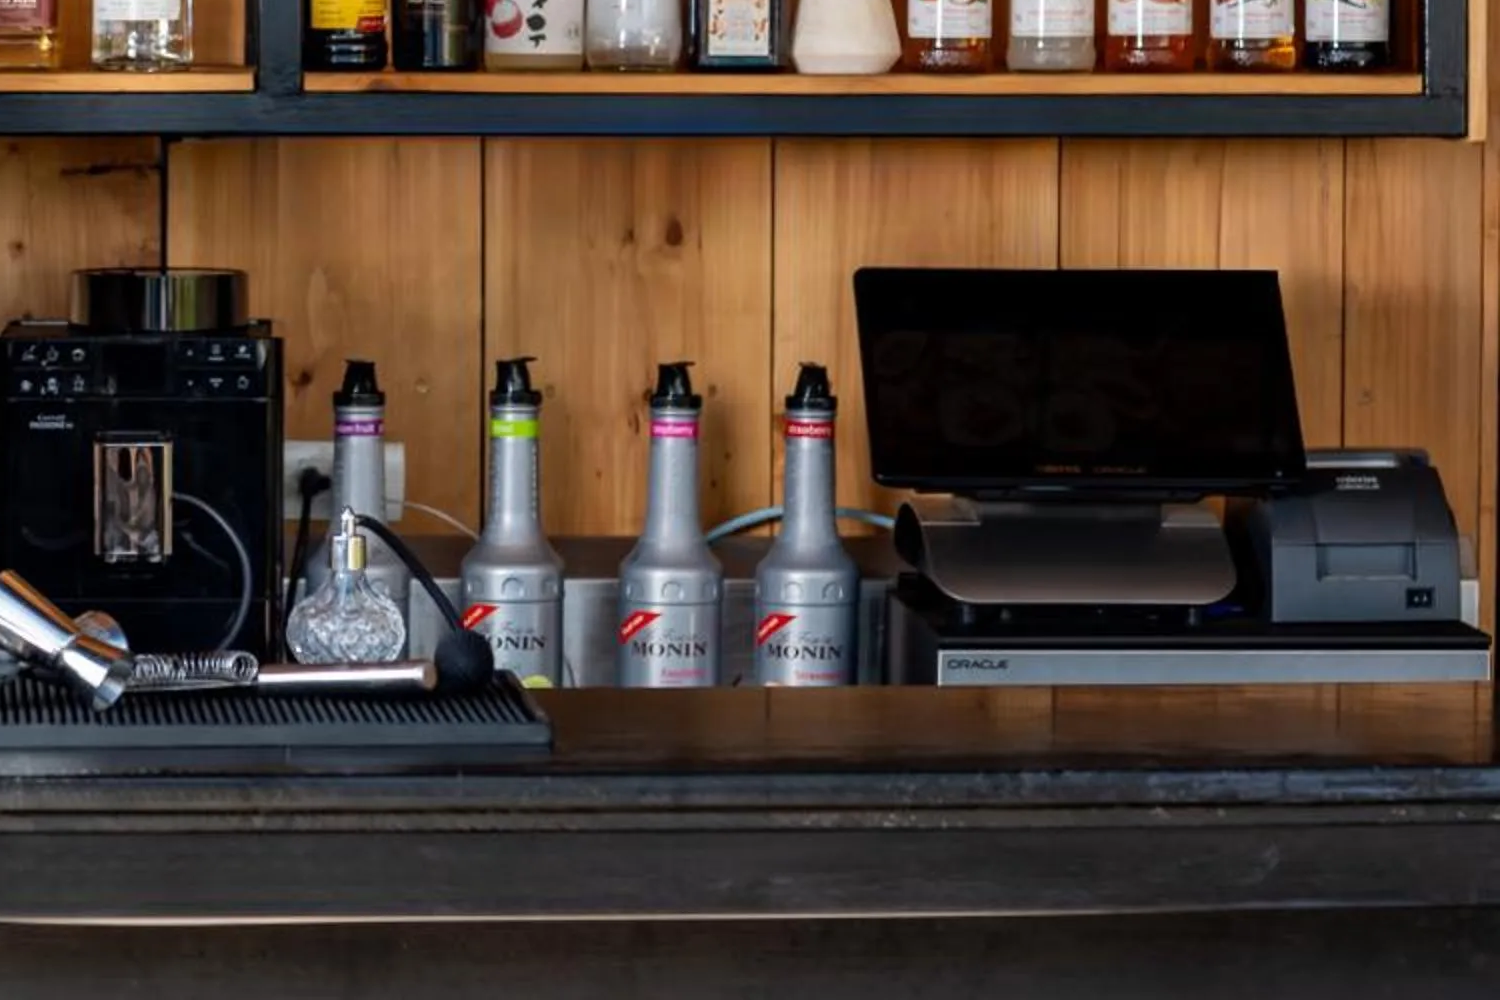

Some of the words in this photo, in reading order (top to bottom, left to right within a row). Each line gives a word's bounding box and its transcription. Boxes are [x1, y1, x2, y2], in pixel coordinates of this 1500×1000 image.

[486, 634, 546, 651] ONIN
[631, 640, 707, 657] MONIN
[767, 643, 842, 660] MONIN
[947, 658, 1009, 670] ORACLE
